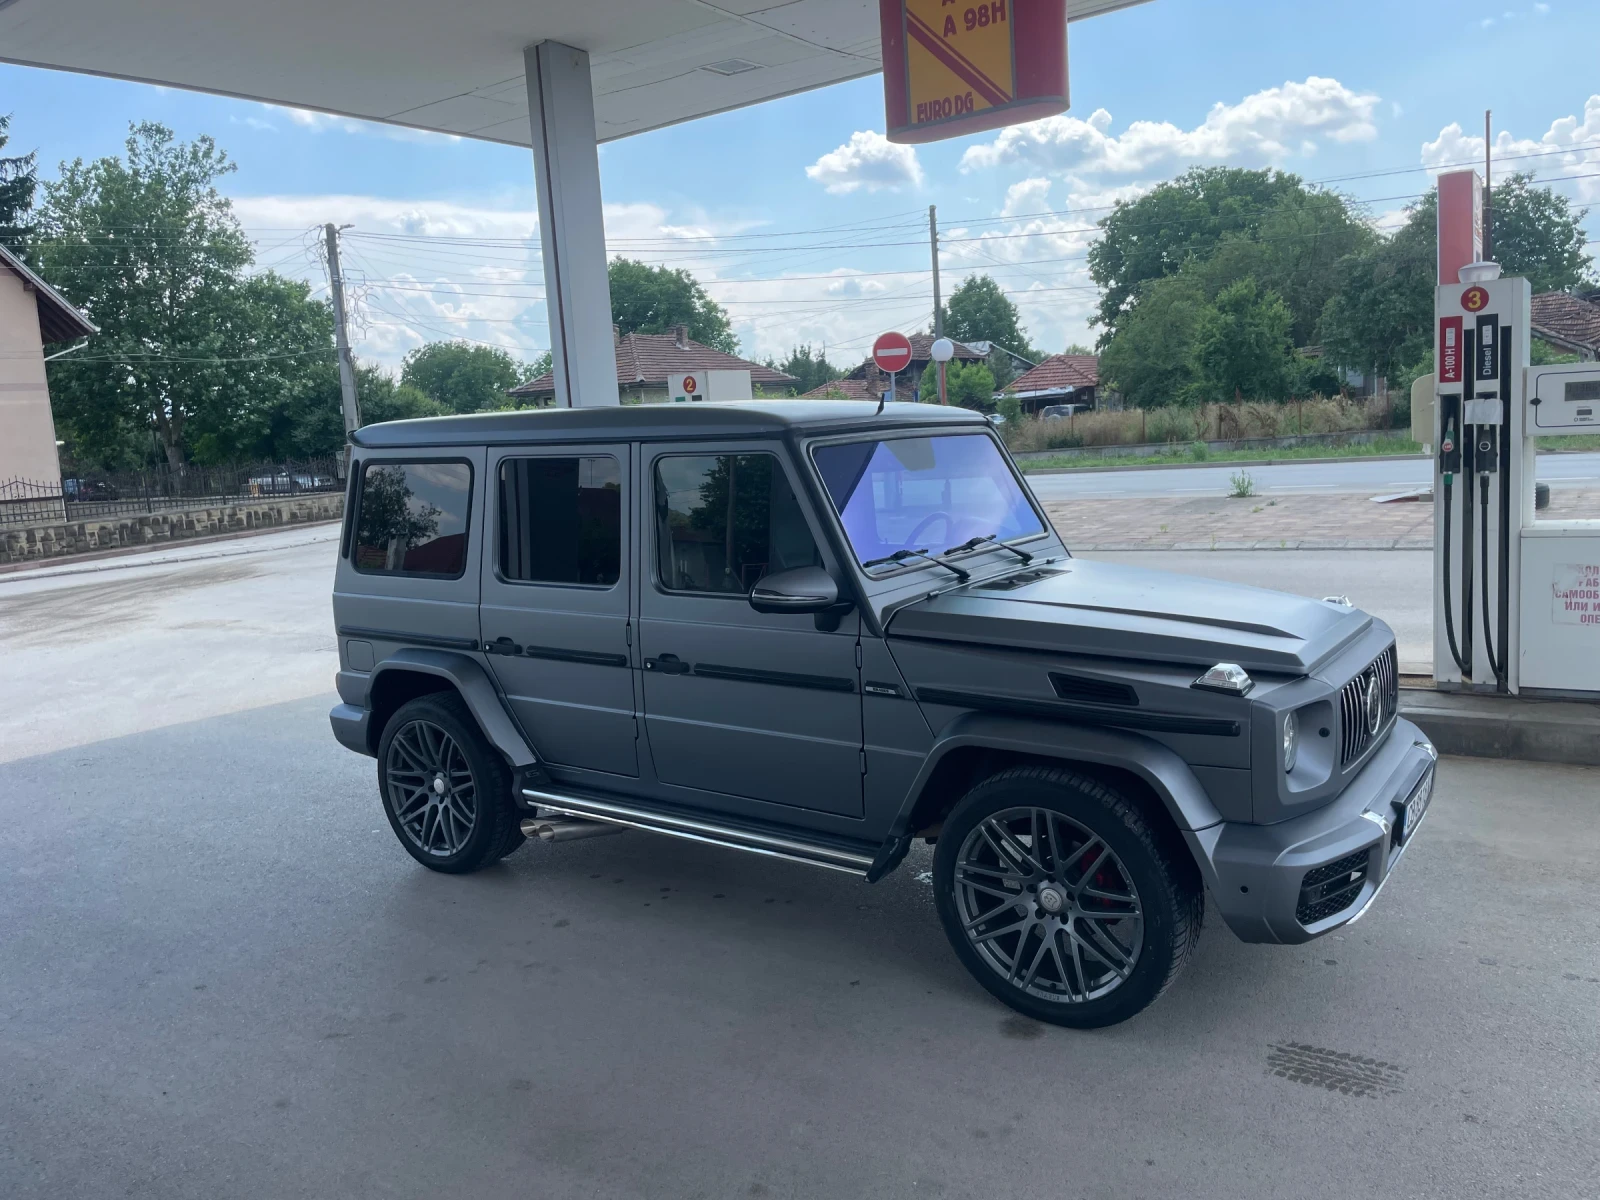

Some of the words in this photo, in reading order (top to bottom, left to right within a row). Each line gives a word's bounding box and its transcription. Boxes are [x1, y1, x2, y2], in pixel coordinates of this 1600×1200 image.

[943, 14, 957, 38] A
[964, 0, 1006, 31] 98H
[917, 97, 952, 123] EURO
[954, 91, 974, 115] DG
[1468, 291, 1481, 308] 3
[1482, 347, 1492, 375] Diesel
[686, 379, 694, 391] 2
[1565, 602, 1588, 611] ИЛИ
